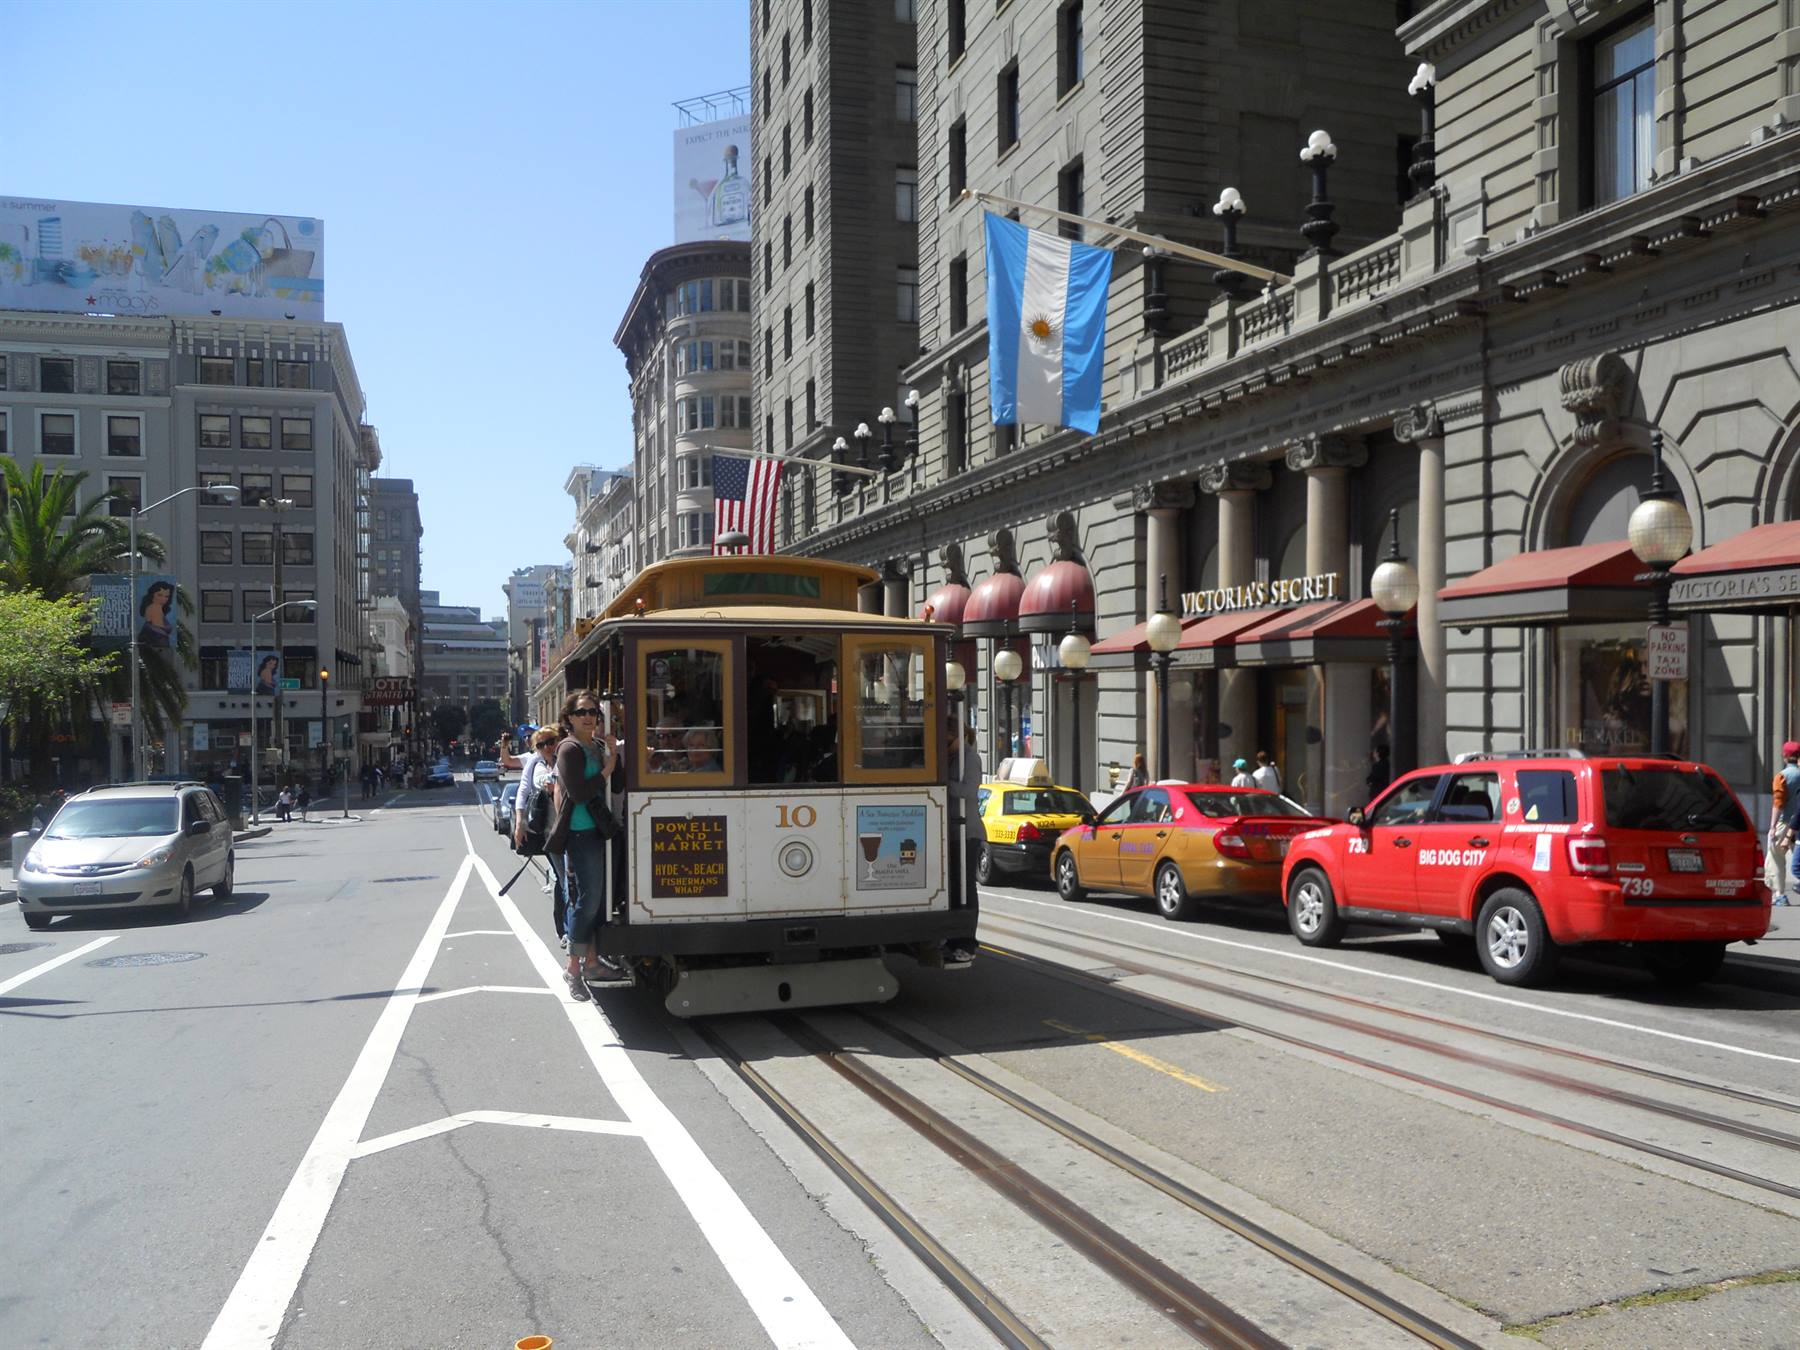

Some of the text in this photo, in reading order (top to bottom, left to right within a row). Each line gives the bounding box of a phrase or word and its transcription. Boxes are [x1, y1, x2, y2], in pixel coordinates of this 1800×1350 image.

[1181, 573, 1337, 613] VICTORIA'S SECRET
[1674, 577, 1770, 600] VICTORIA'S
[93, 600, 130, 612] WARDS
[1661, 631, 1675, 642] NO
[1651, 642, 1686, 654] PARKING
[1657, 655, 1680, 664] TAXI
[1654, 665, 1681, 676] ZONE
[776, 805, 817, 828] 10
[655, 822, 722, 833] POWELL
[673, 832, 706, 841] AND
[655, 840, 724, 852] MARKET
[1419, 849, 1487, 866] BIG DOG CITY
[655, 864, 679, 875] HYDE
[694, 863, 724, 875] BEACH
[674, 886, 705, 895] WHARF
[1619, 877, 1654, 896] 739
